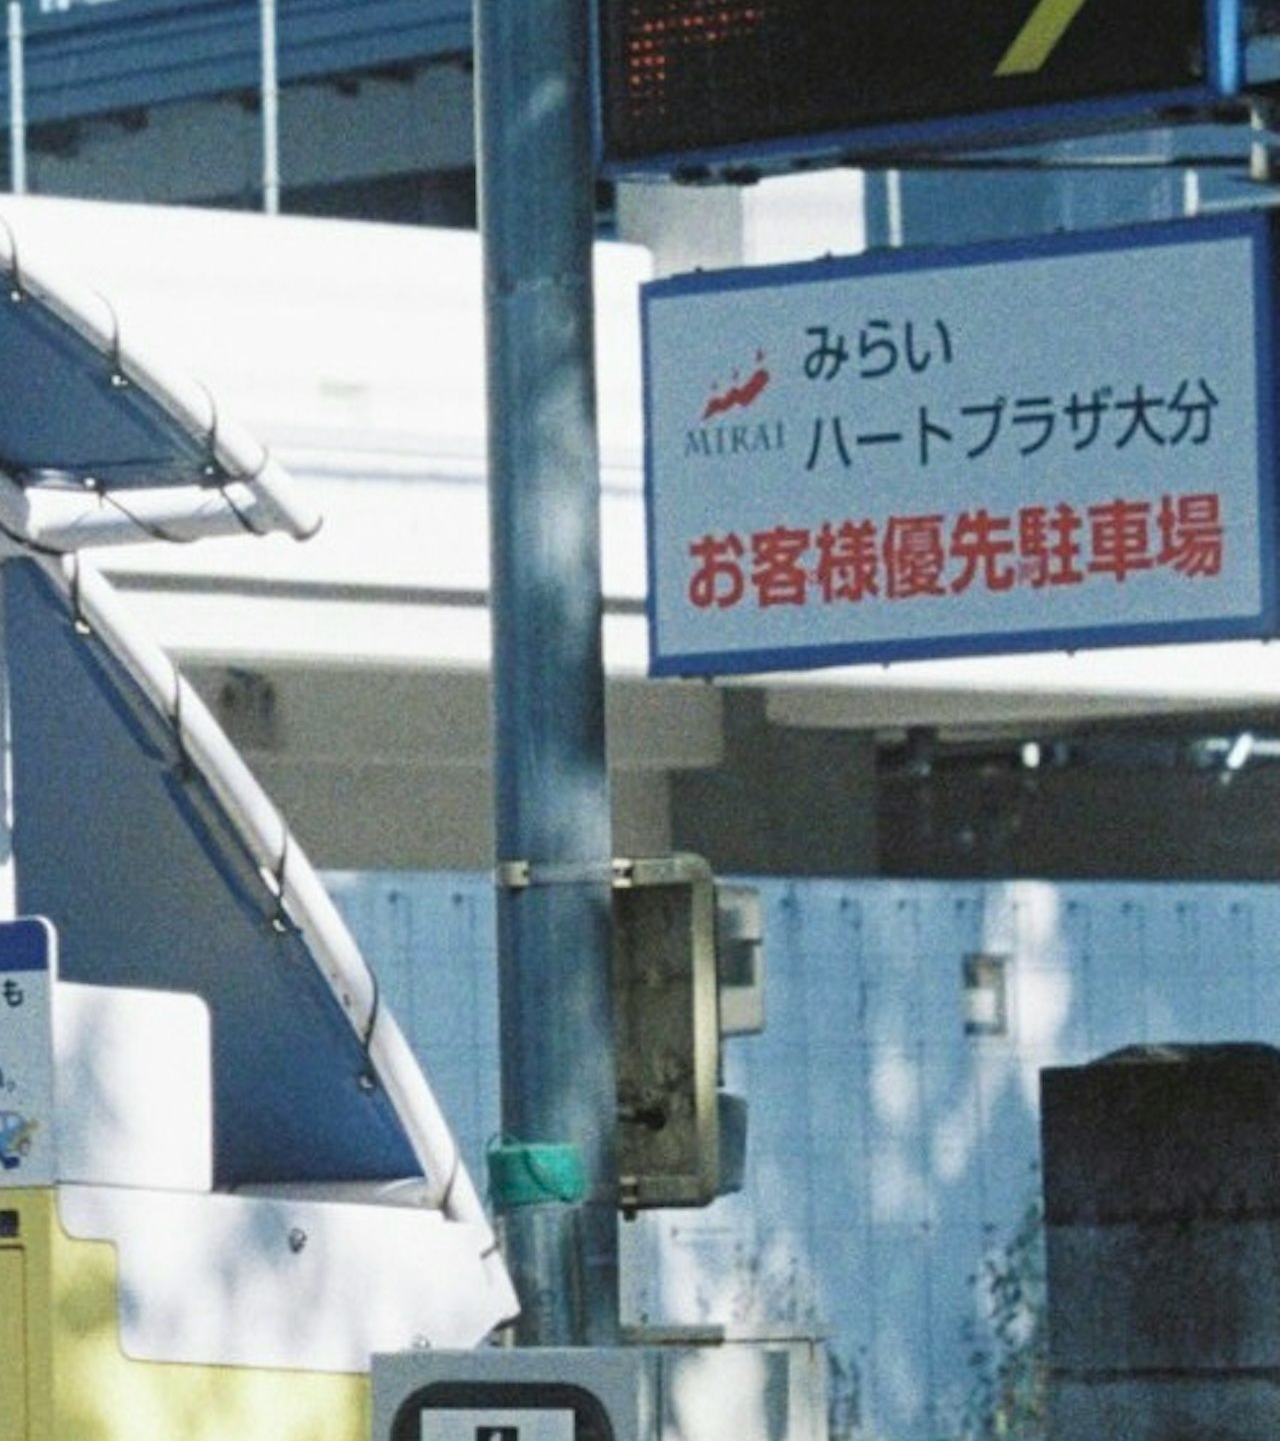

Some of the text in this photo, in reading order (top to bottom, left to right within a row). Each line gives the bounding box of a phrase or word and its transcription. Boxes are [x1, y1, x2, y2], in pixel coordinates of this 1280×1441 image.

[803, 319, 953, 381] みらい
[684, 419, 787, 459] MIRAI
[806, 378, 1219, 471] ハートプラザ大分
[689, 494, 1223, 608] お客様優先駐車場
